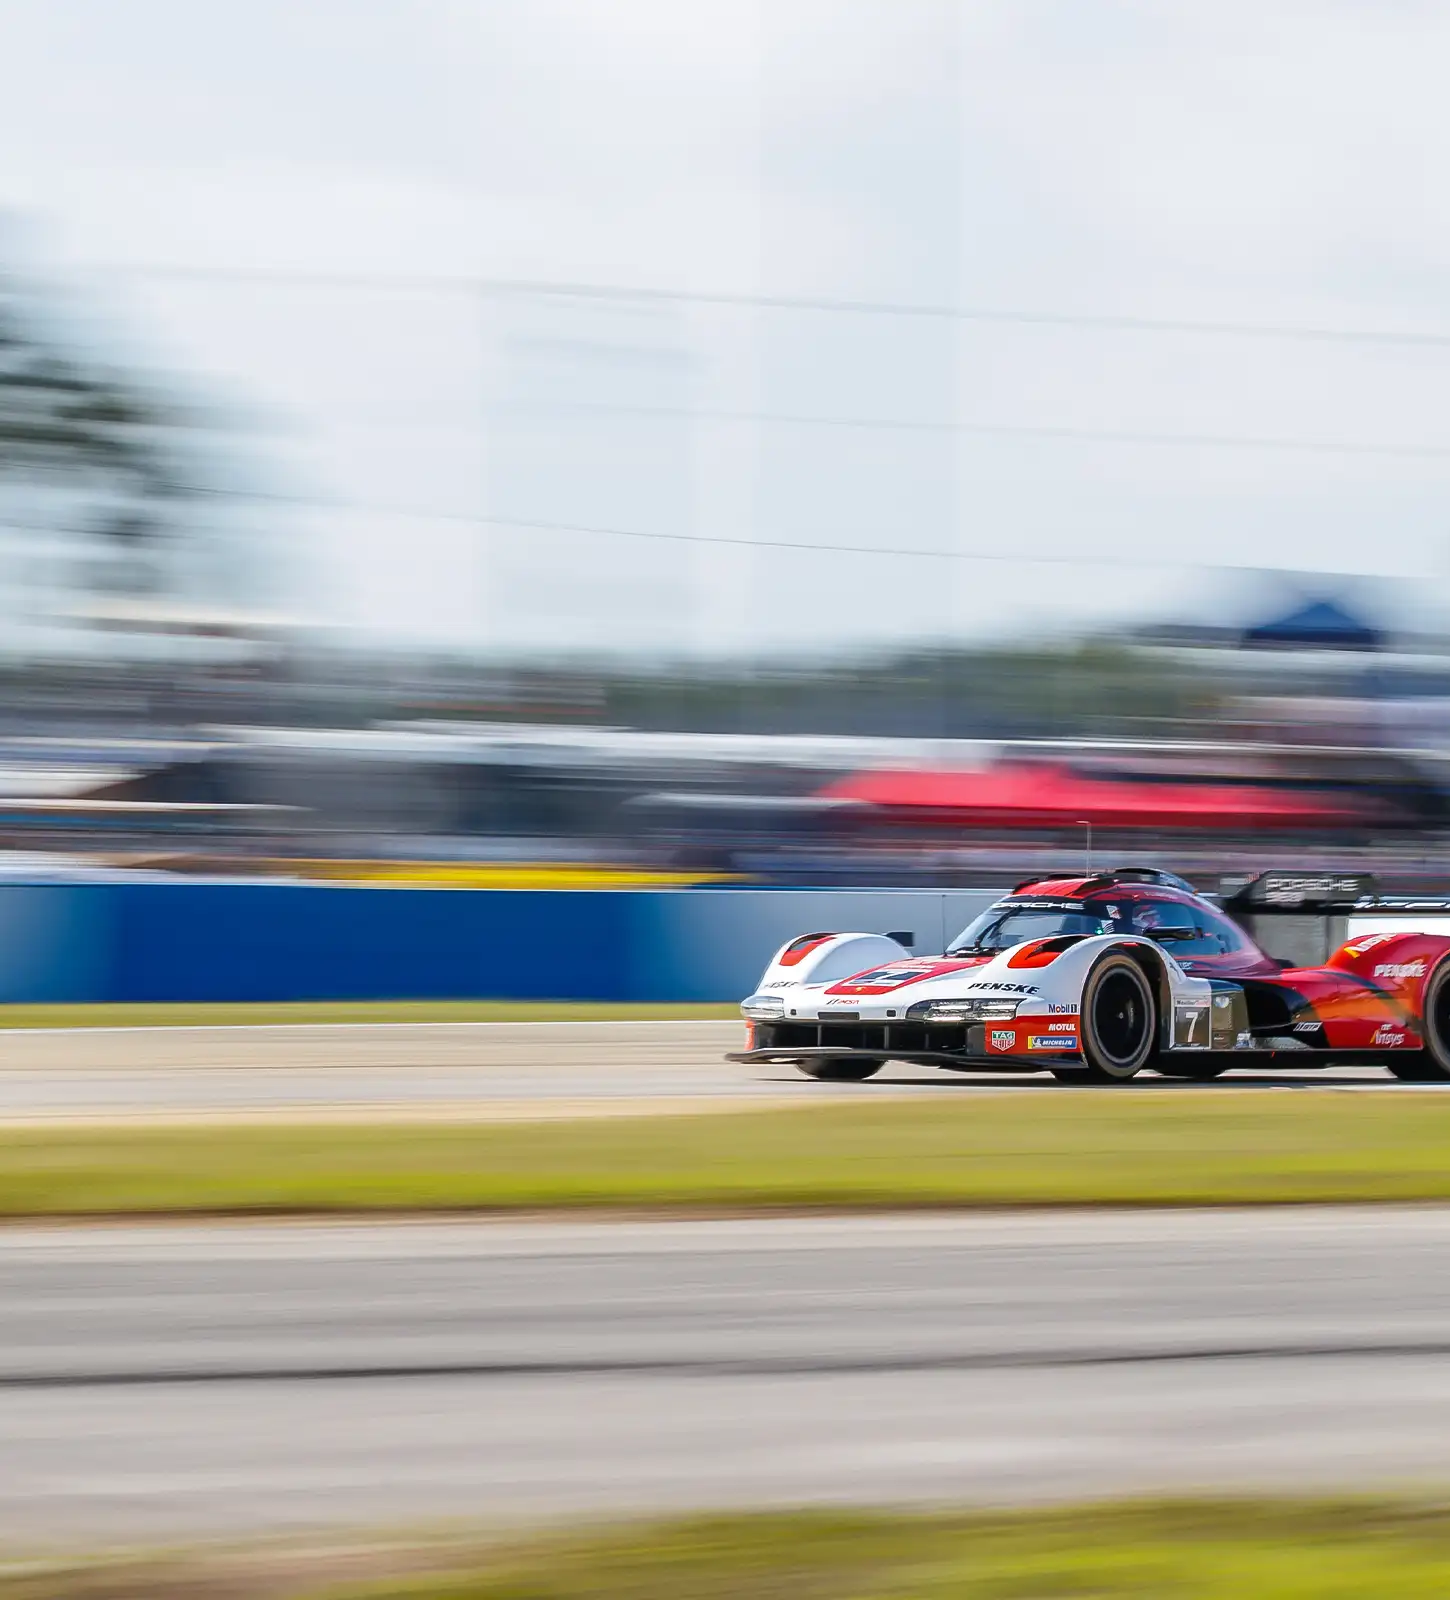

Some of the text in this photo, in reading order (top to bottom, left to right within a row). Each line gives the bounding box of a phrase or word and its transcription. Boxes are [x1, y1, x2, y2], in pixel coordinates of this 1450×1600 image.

[1265, 879, 1359, 891] PORSCHE
[1374, 964, 1428, 978] PENSKE
[967, 983, 1040, 995] PENSKE
[1048, 1004, 1070, 1013] Mobil
[1048, 1023, 1076, 1031] MOTUL
[1185, 1011, 1199, 1043] 7
